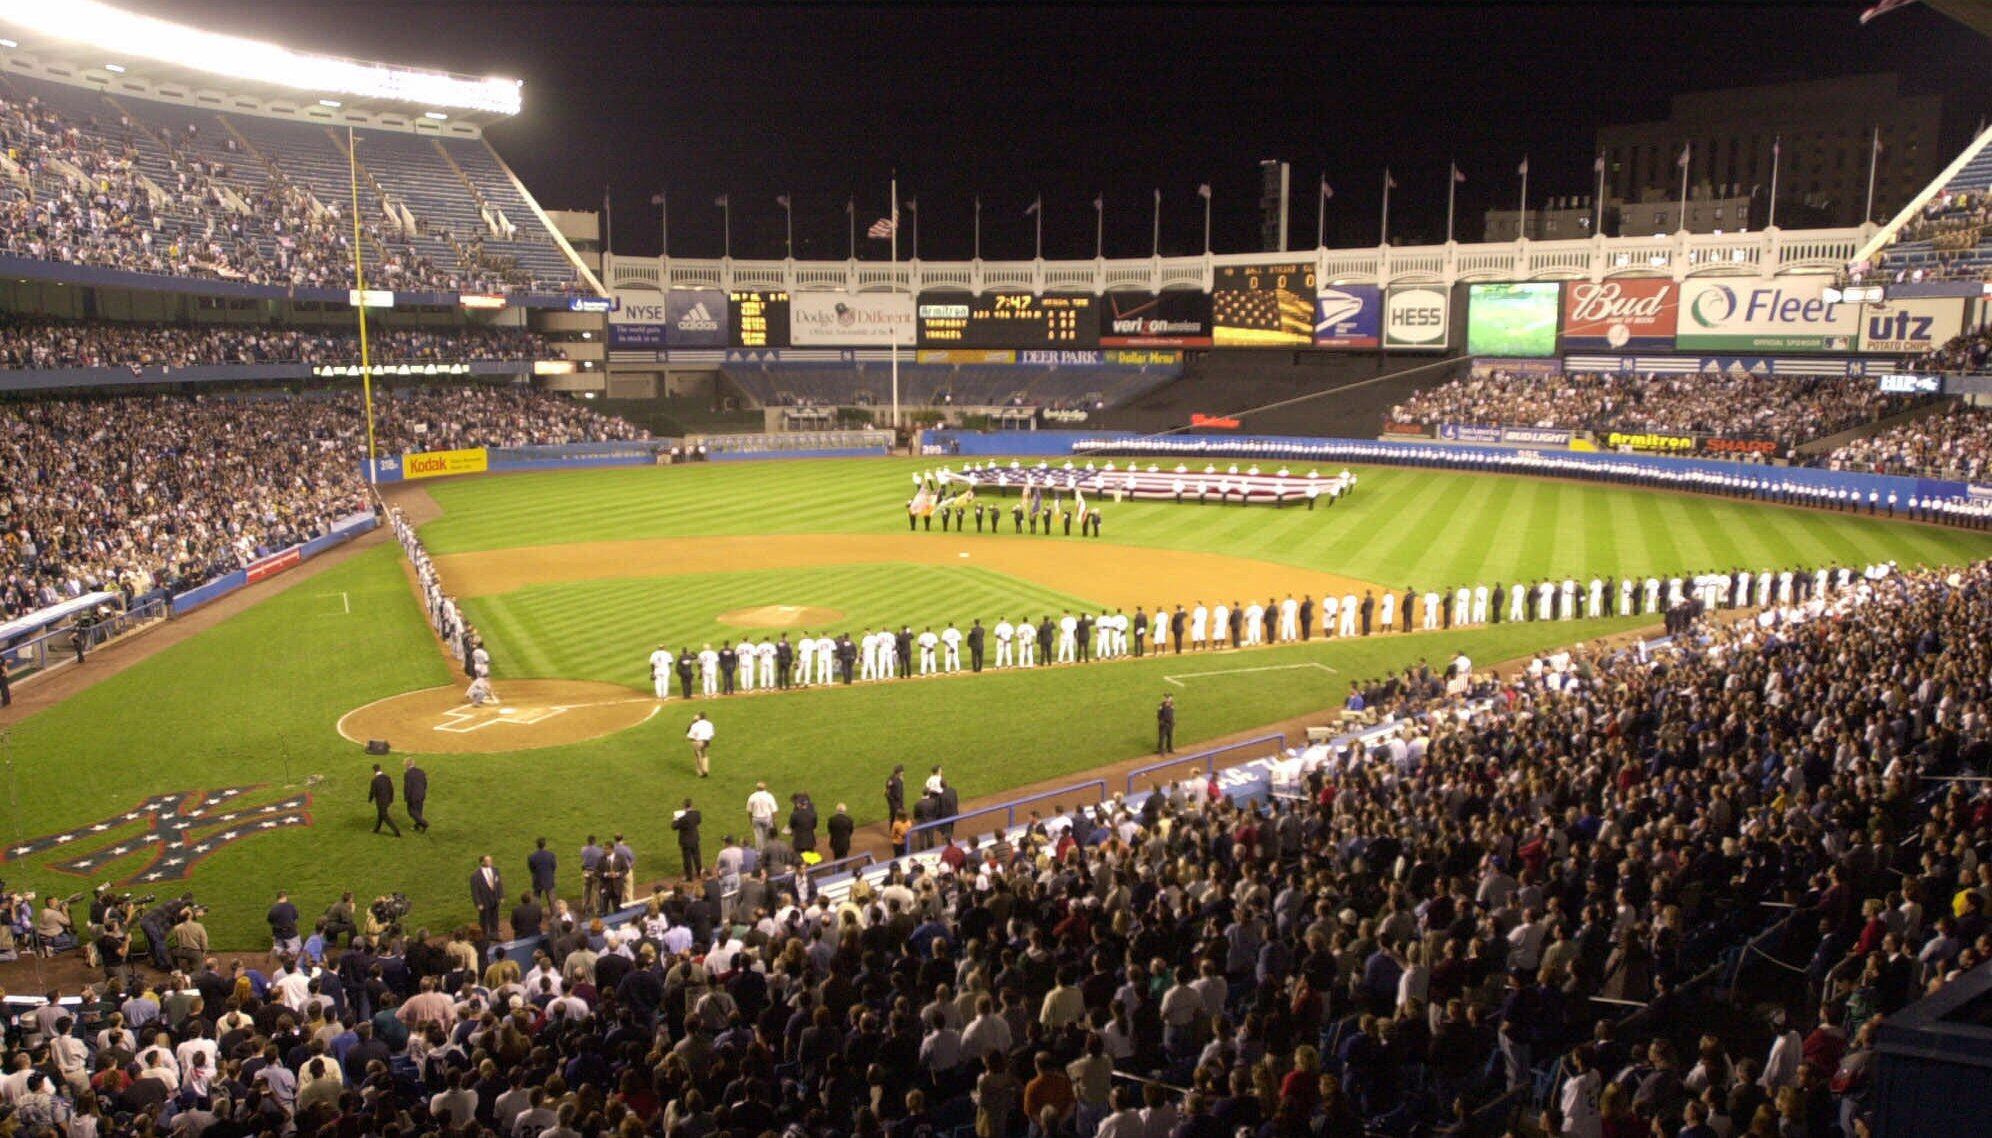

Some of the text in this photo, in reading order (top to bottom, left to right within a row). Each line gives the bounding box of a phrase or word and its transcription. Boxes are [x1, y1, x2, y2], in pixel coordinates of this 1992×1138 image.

[1249, 274, 1315, 289] 0 0 0
[995, 295, 1031, 309] 7:47
[1571, 282, 1671, 322] Bud
[1745, 289, 1838, 322] Fleet
[625, 305, 663, 320] NYSE
[795, 309, 835, 326] Dodge
[1391, 307, 1441, 326] HESS
[677, 319, 719, 331] adidas
[1112, 317, 1167, 335] verizon
[1869, 311, 1933, 340] utz
[1866, 341, 1901, 350] POTATO
[1022, 351, 1056, 363] DEER
[1061, 351, 1099, 363] PARK
[1505, 432, 1569, 443] BUD LIGHT
[1609, 433, 1691, 448] Armitron
[1707, 439, 1776, 453] SHARP
[410, 457, 446, 474] Kodak
